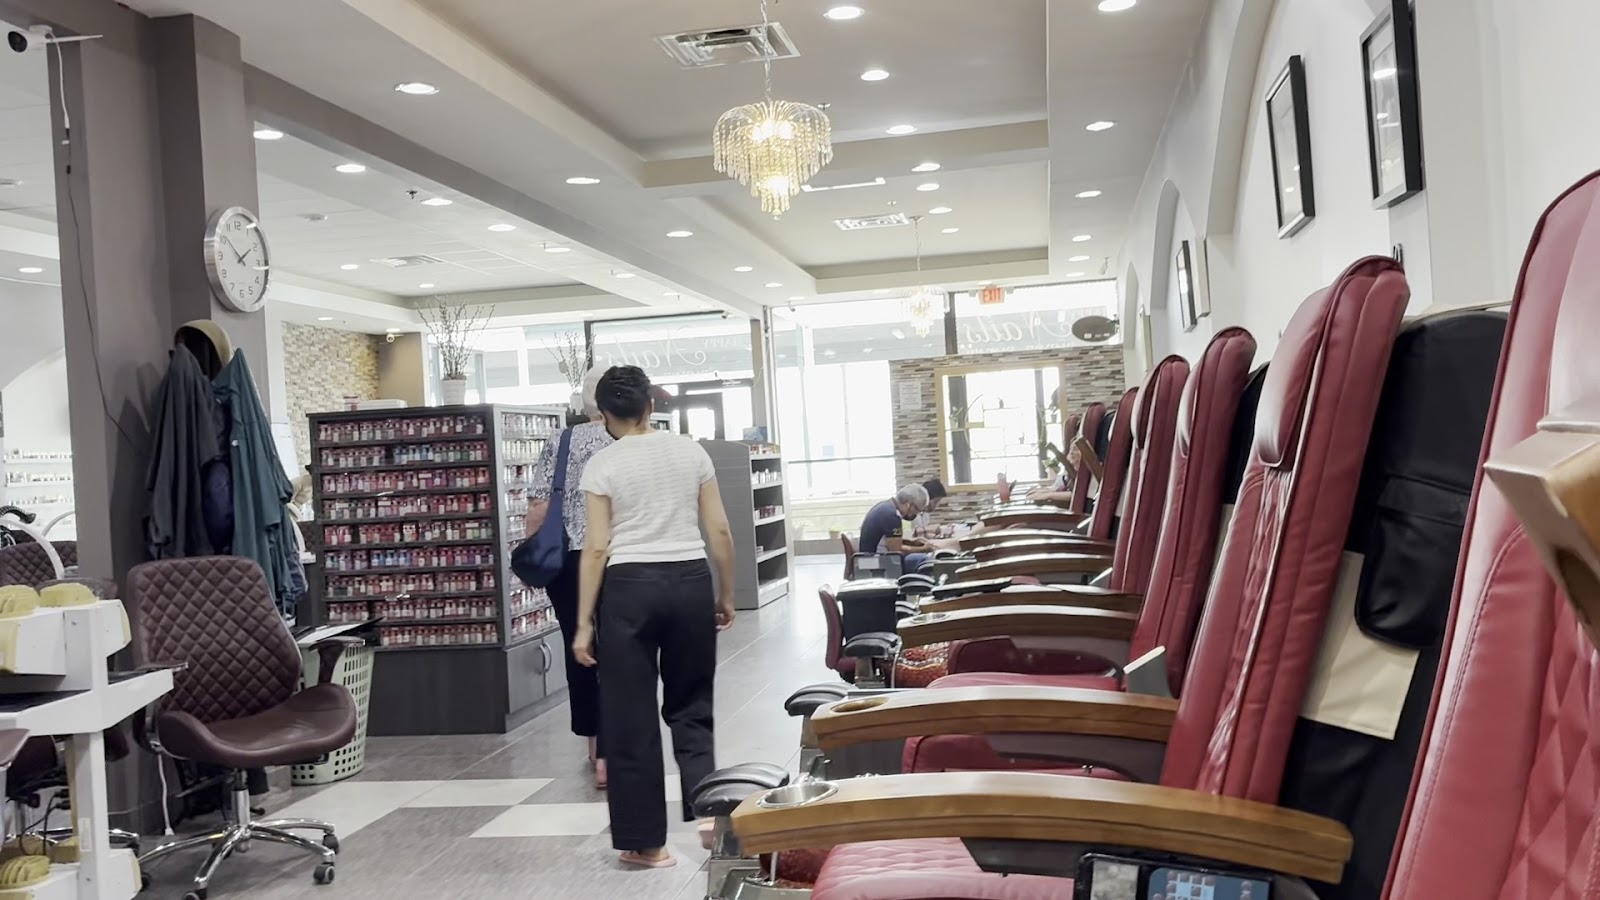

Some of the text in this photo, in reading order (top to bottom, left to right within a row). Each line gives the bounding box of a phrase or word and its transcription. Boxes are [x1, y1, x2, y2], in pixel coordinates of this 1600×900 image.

[225, 223, 231, 232] 11
[233, 220, 241, 231] 12
[252, 242, 258, 252] 2
[218, 251, 224, 261] 9
[222, 269, 227, 279] 8
[230, 282, 236, 291] 7
[248, 285, 254, 296] 5
[239, 289, 245, 299] 6
[982, 287, 1001, 303] EXIT
